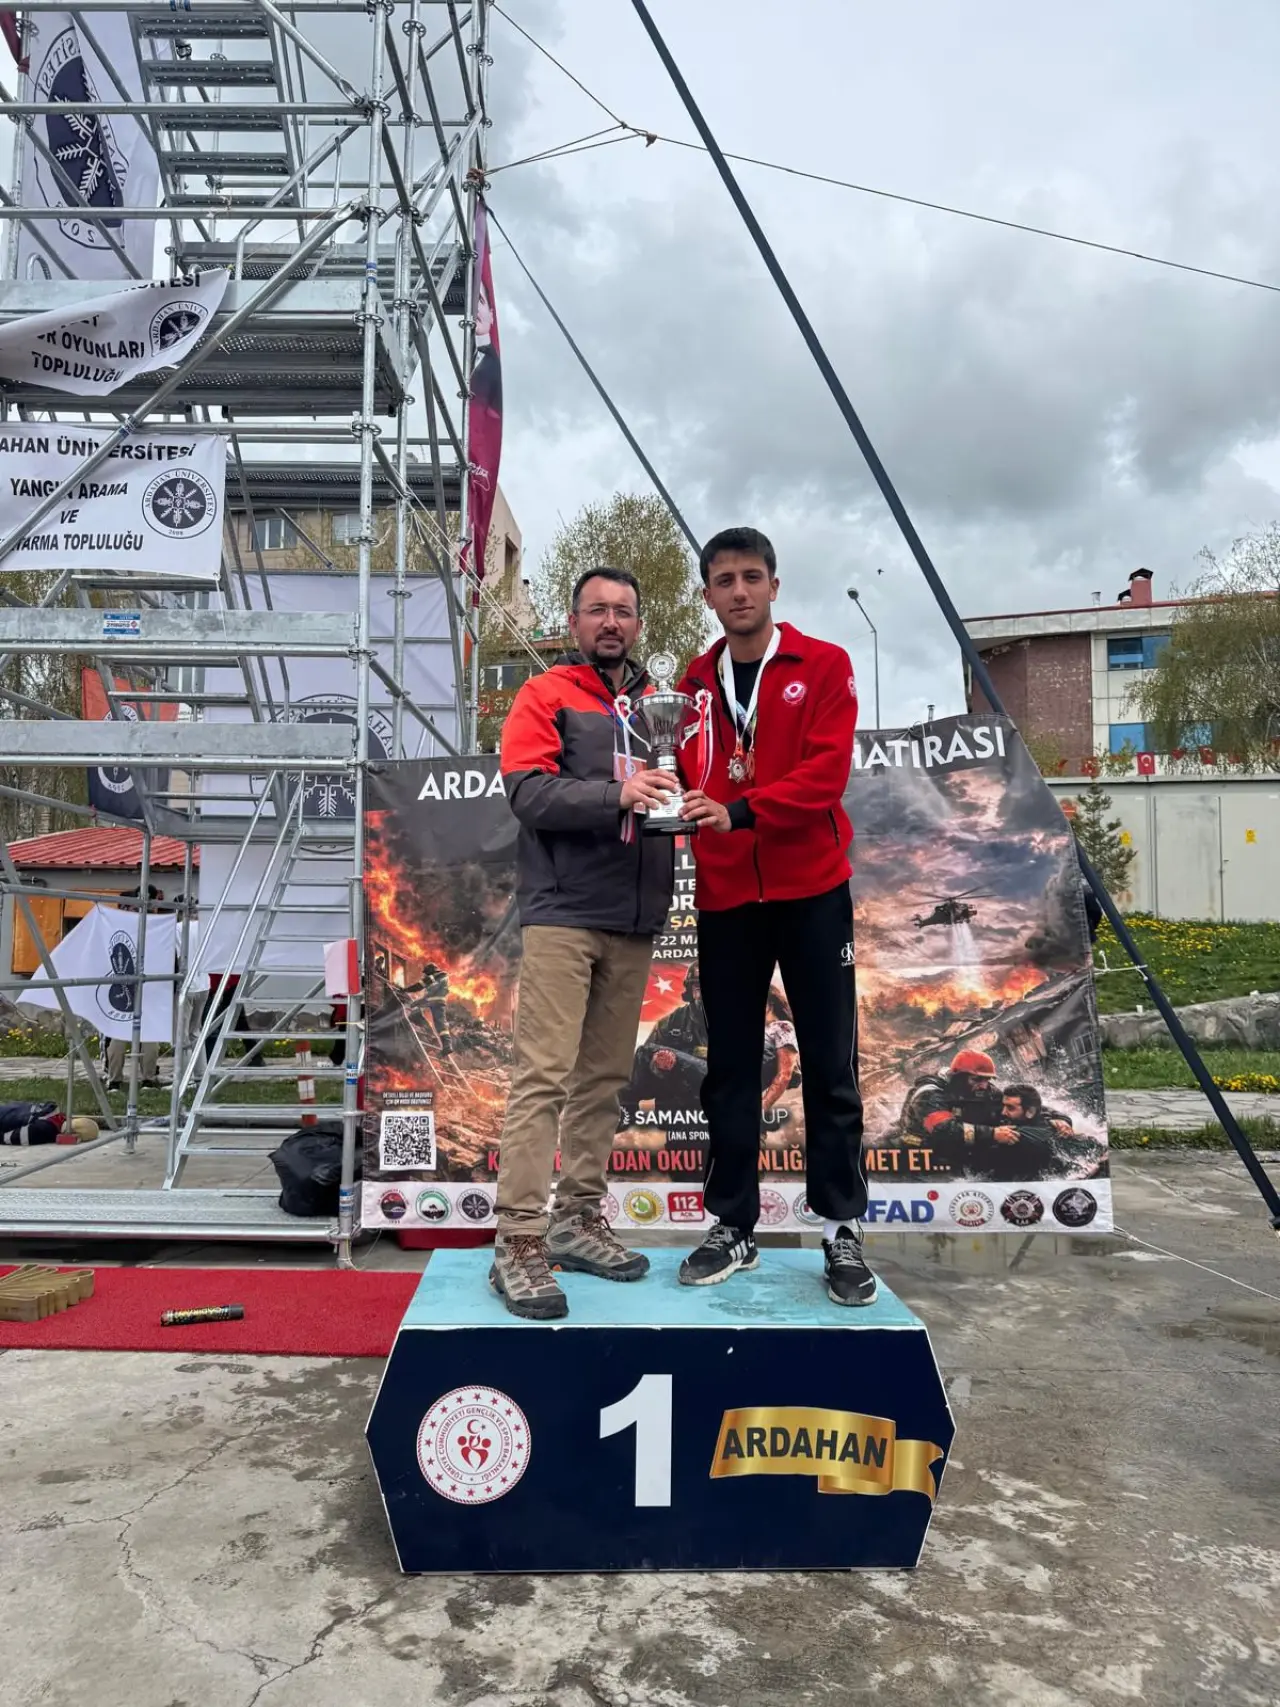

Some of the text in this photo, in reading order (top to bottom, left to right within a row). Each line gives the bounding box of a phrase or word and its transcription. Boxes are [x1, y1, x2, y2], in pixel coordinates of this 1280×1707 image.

[61, 332, 145, 359] OYUNLARI
[31, 351, 125, 382] TOPLULUĞU
[78, 482, 128, 499] ARAMA
[60, 509, 79, 524] VE
[10, 530, 144, 551] TARMA TOPLULUĞU
[660, 936, 677, 946] 22
[605, 1150, 651, 1171] DAN
[657, 1150, 703, 1171] OKU!
[758, 1144, 807, 1171] NLIĞ
[673, 1196, 699, 1210] 112
[438, 1407, 510, 1481] TÜRKİYE CUMHURİYETİ GENÇLİK VE SPOR BAKANLIĞI
[600, 1374, 672, 1506] 1
[722, 1426, 888, 1467] ARDAHAN
